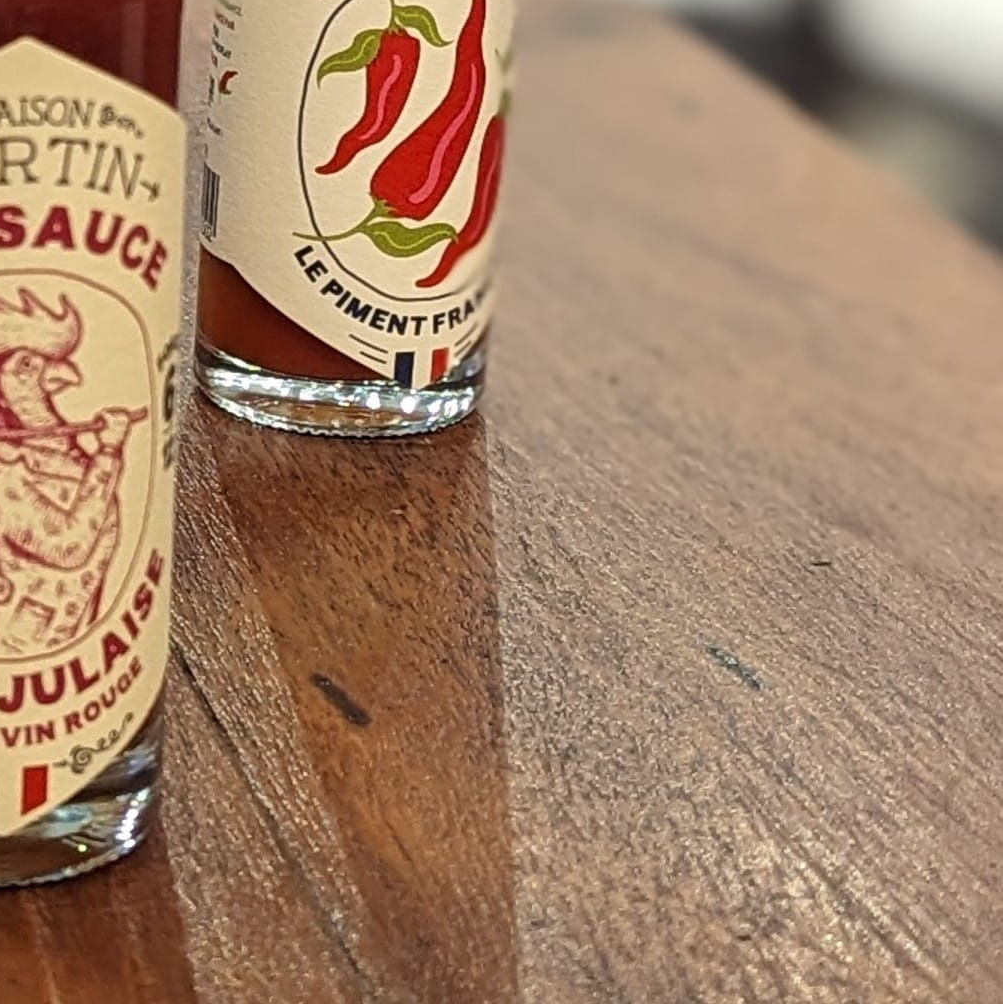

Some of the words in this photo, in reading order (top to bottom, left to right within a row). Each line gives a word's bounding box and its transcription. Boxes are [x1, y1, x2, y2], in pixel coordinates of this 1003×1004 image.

[293, 245, 330, 284] LE
[320, 281, 428, 337] PIMENT
[0, 720, 56, 749] VIN
[64, 656, 144, 736] ROUGE
